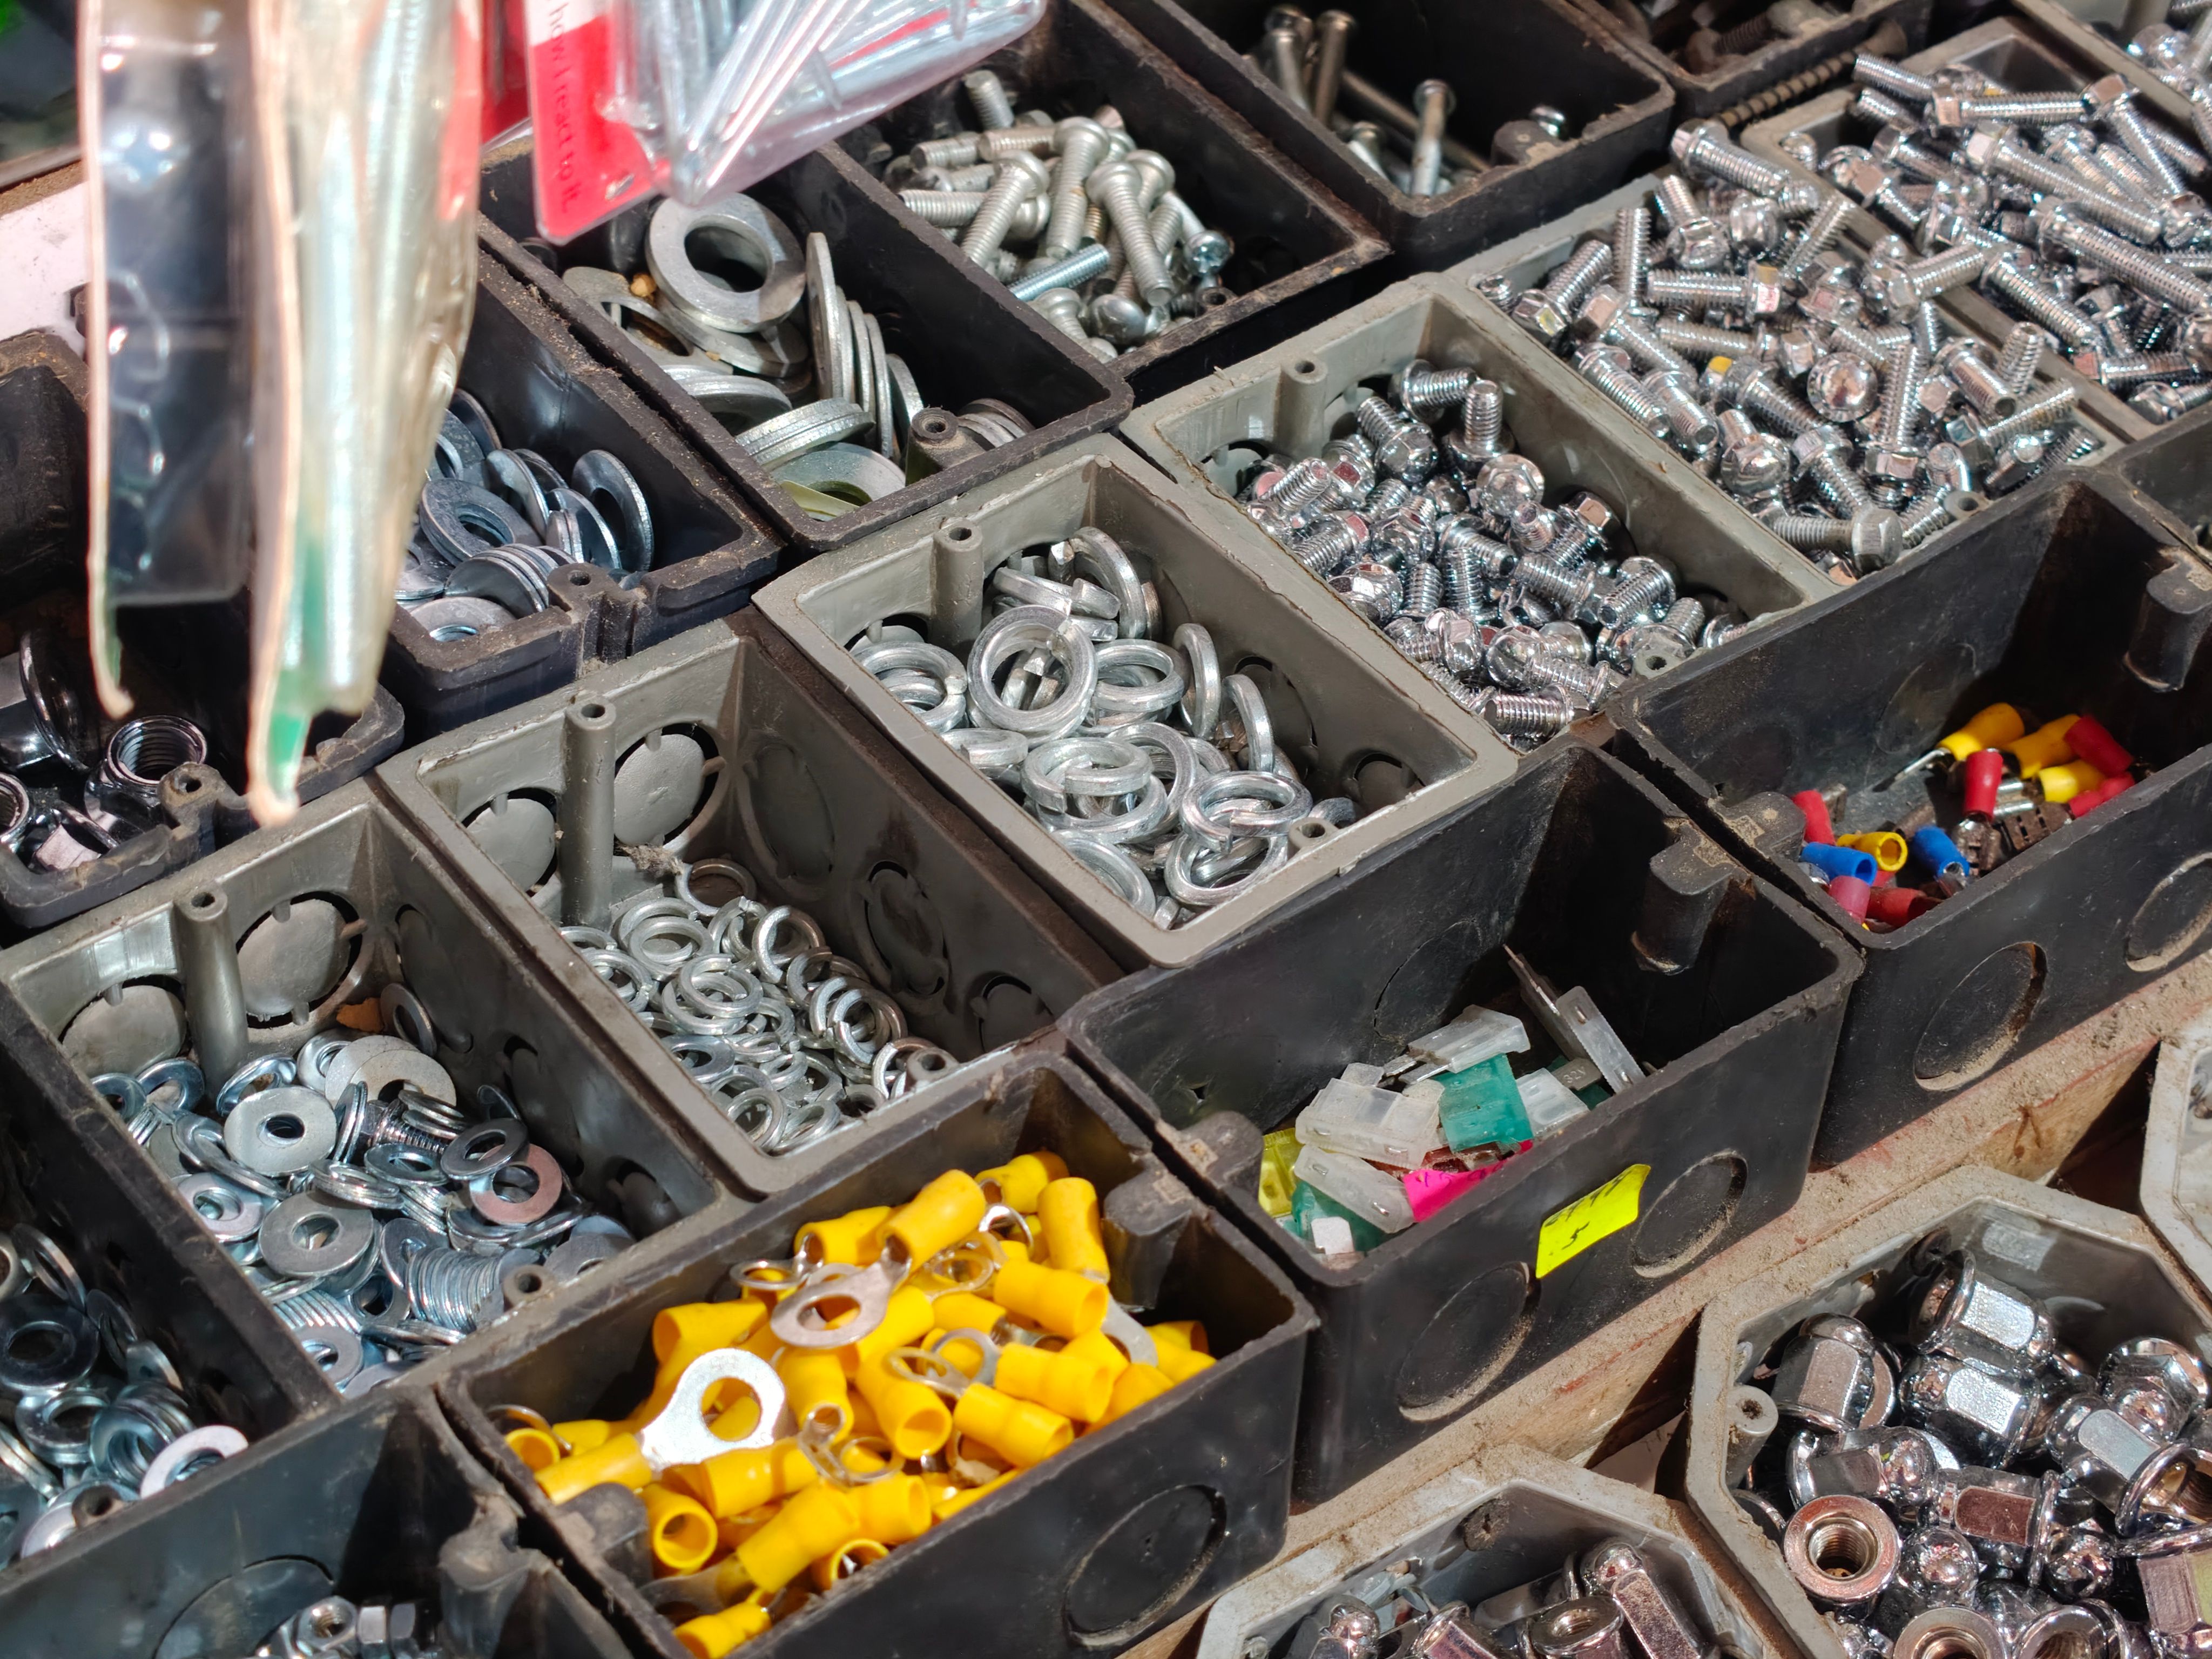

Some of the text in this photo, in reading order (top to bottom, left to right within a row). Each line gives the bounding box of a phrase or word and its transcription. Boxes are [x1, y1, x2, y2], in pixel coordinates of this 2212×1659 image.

[549, 2, 569, 62] how
[554, 84, 574, 150] react
[559, 151, 575, 182] to
[1563, 1066, 1586, 1083] 32V
